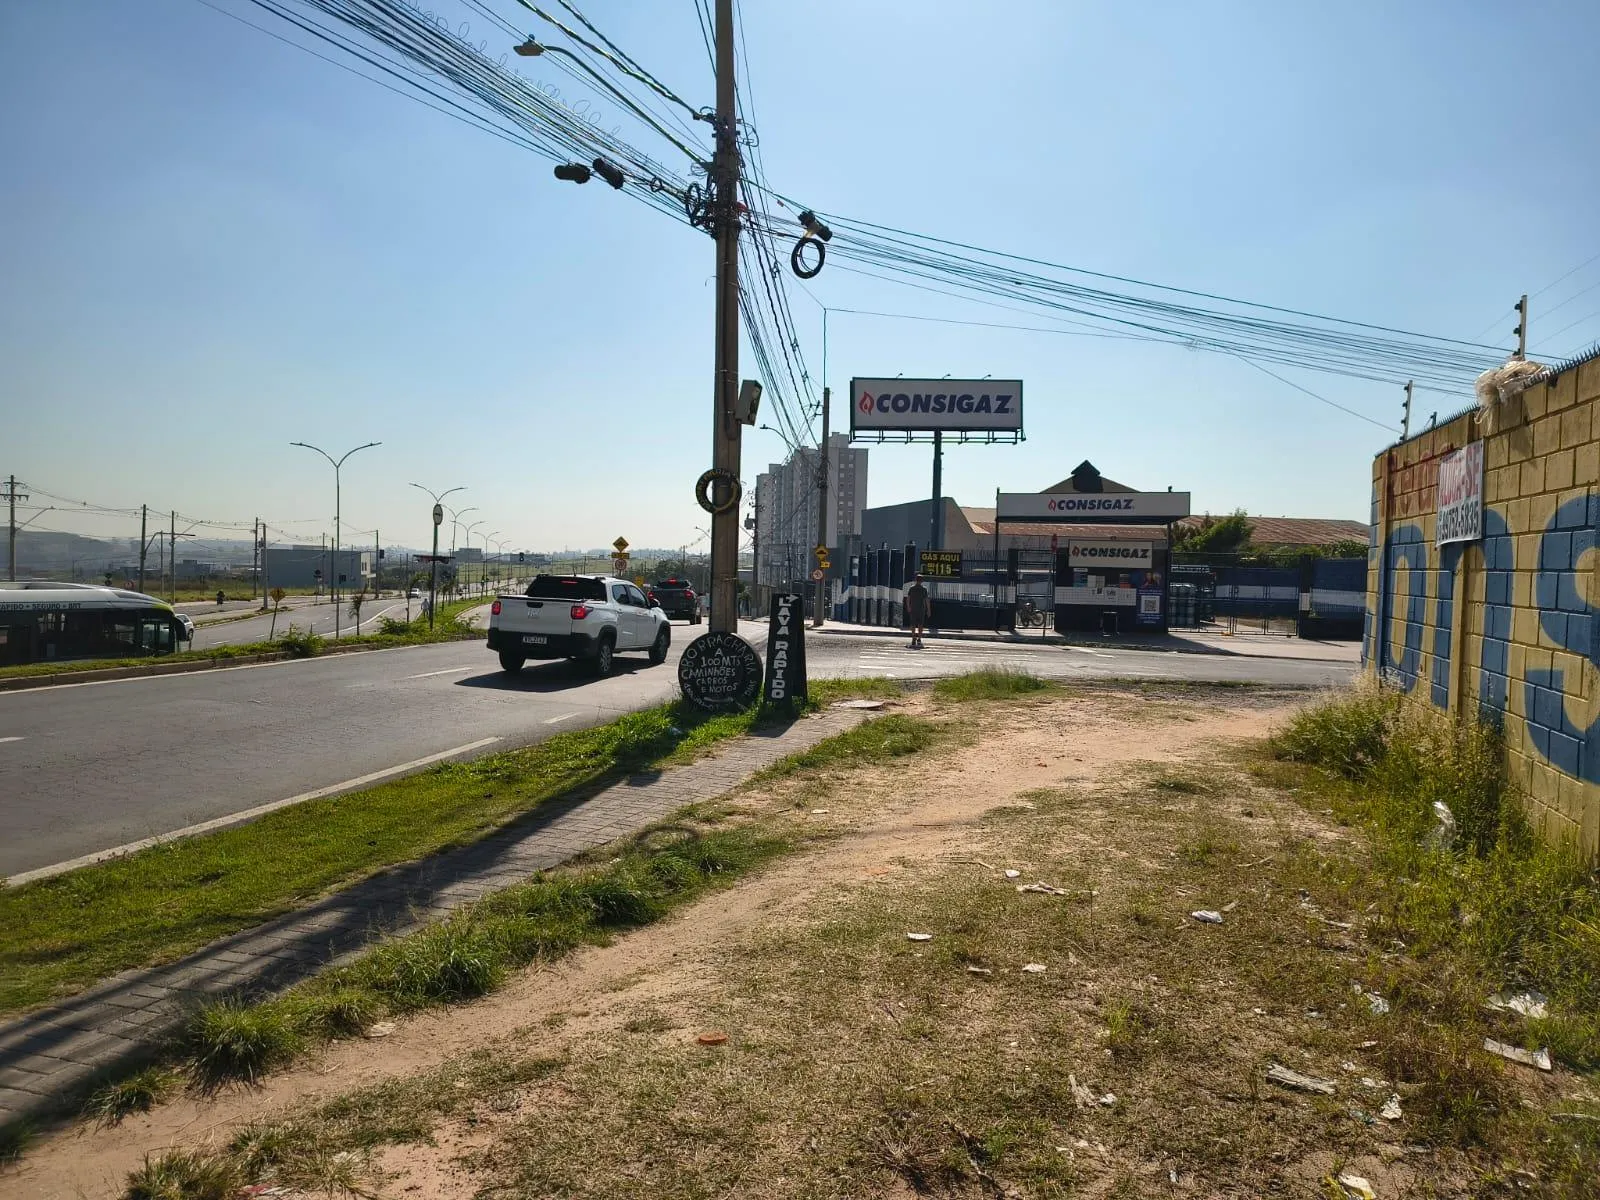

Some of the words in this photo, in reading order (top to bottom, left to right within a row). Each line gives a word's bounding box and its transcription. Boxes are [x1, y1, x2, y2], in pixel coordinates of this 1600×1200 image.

[876, 393, 1013, 414] CONSIGAZ
[1057, 498, 1134, 511] CONSIGAZ
[939, 554, 960, 562] AQUI
[1080, 547, 1149, 559] CONSIGAZ
[776, 597, 791, 635] LAVA
[714, 648, 724, 657] A
[771, 641, 788, 699] RAPIDO
